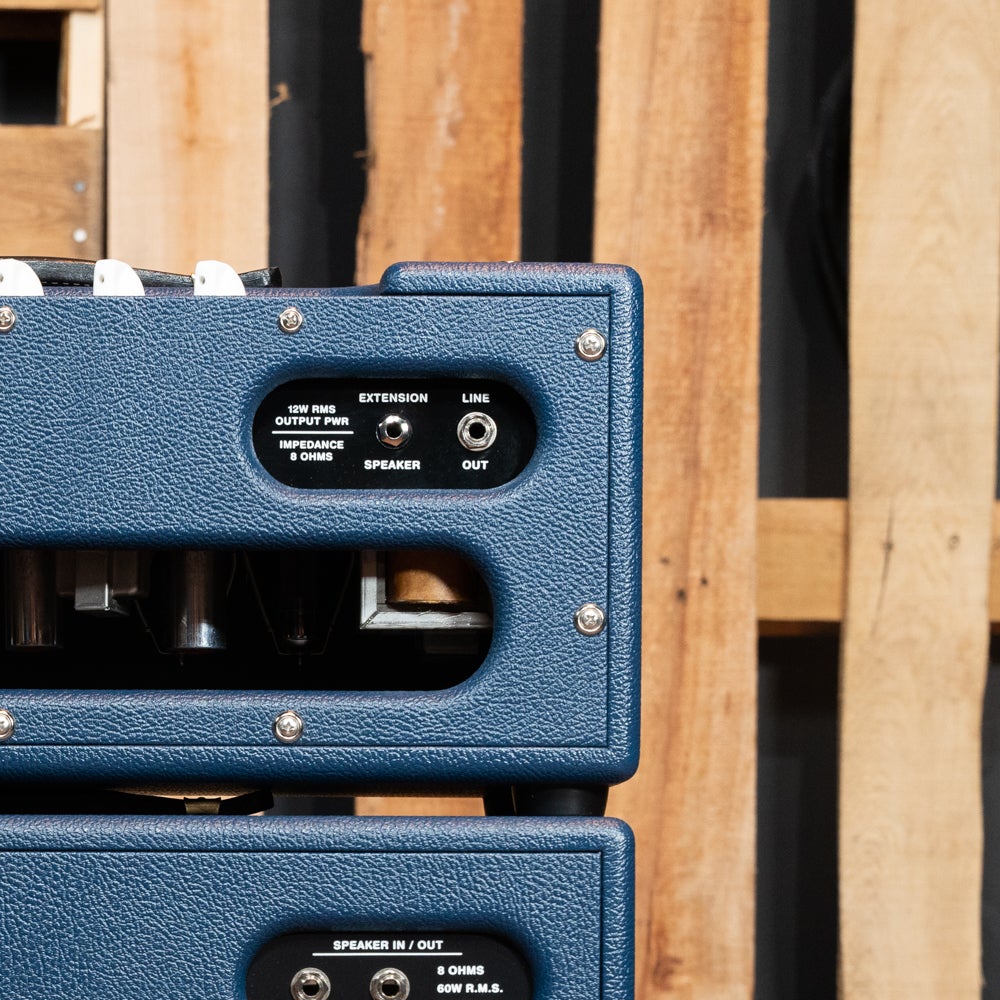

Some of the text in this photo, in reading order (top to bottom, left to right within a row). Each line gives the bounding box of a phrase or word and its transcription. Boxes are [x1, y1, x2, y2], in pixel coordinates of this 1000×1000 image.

[358, 393, 428, 403] EXTENSION
[461, 393, 490, 403] LINE
[287, 405, 336, 414] 12W RMS
[275, 416, 349, 426] OUTPUT PWR
[279, 440, 344, 449] IMPEDANCE
[289, 452, 333, 461] 8 OHMS
[364, 459, 421, 470] SPEAKER
[462, 459, 489, 470] OUT
[332, 940, 389, 950] SPEAKER
[392, 940, 406, 950] IN
[416, 940, 444, 950] OUT
[436, 965, 485, 975] 8 OHMS
[436, 983, 504, 993] 60W R.M.S.
